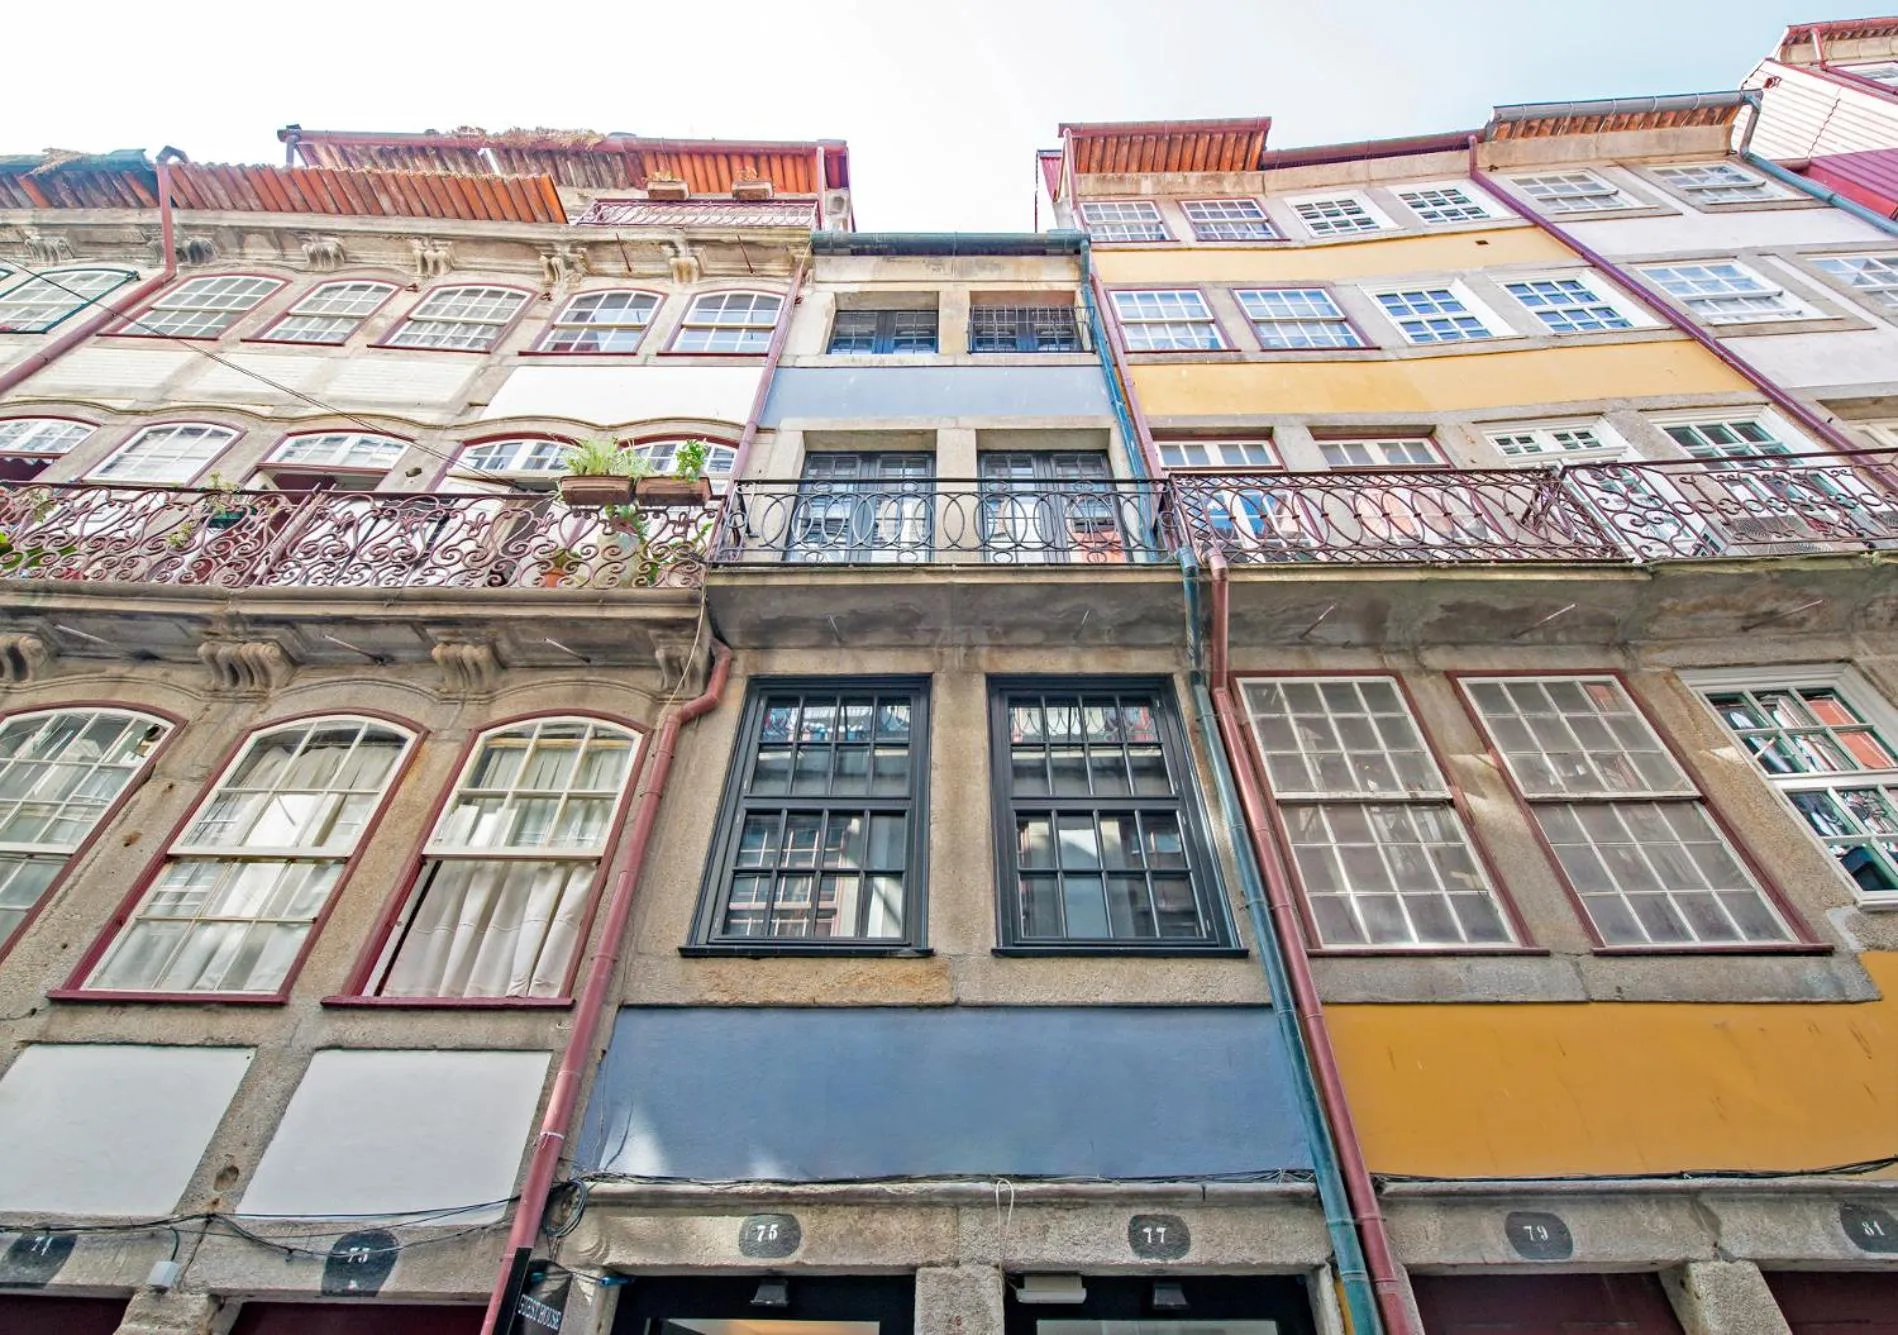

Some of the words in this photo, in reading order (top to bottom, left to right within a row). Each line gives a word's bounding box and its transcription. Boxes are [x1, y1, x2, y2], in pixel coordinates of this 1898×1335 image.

[757, 1224, 779, 1242] 75
[1142, 1227, 1167, 1243] 77
[1523, 1225, 1549, 1241] 79
[1861, 1220, 1886, 1237] 81
[518, 1293, 541, 1320] GUEST
[537, 1303, 562, 1330] HOUSE
